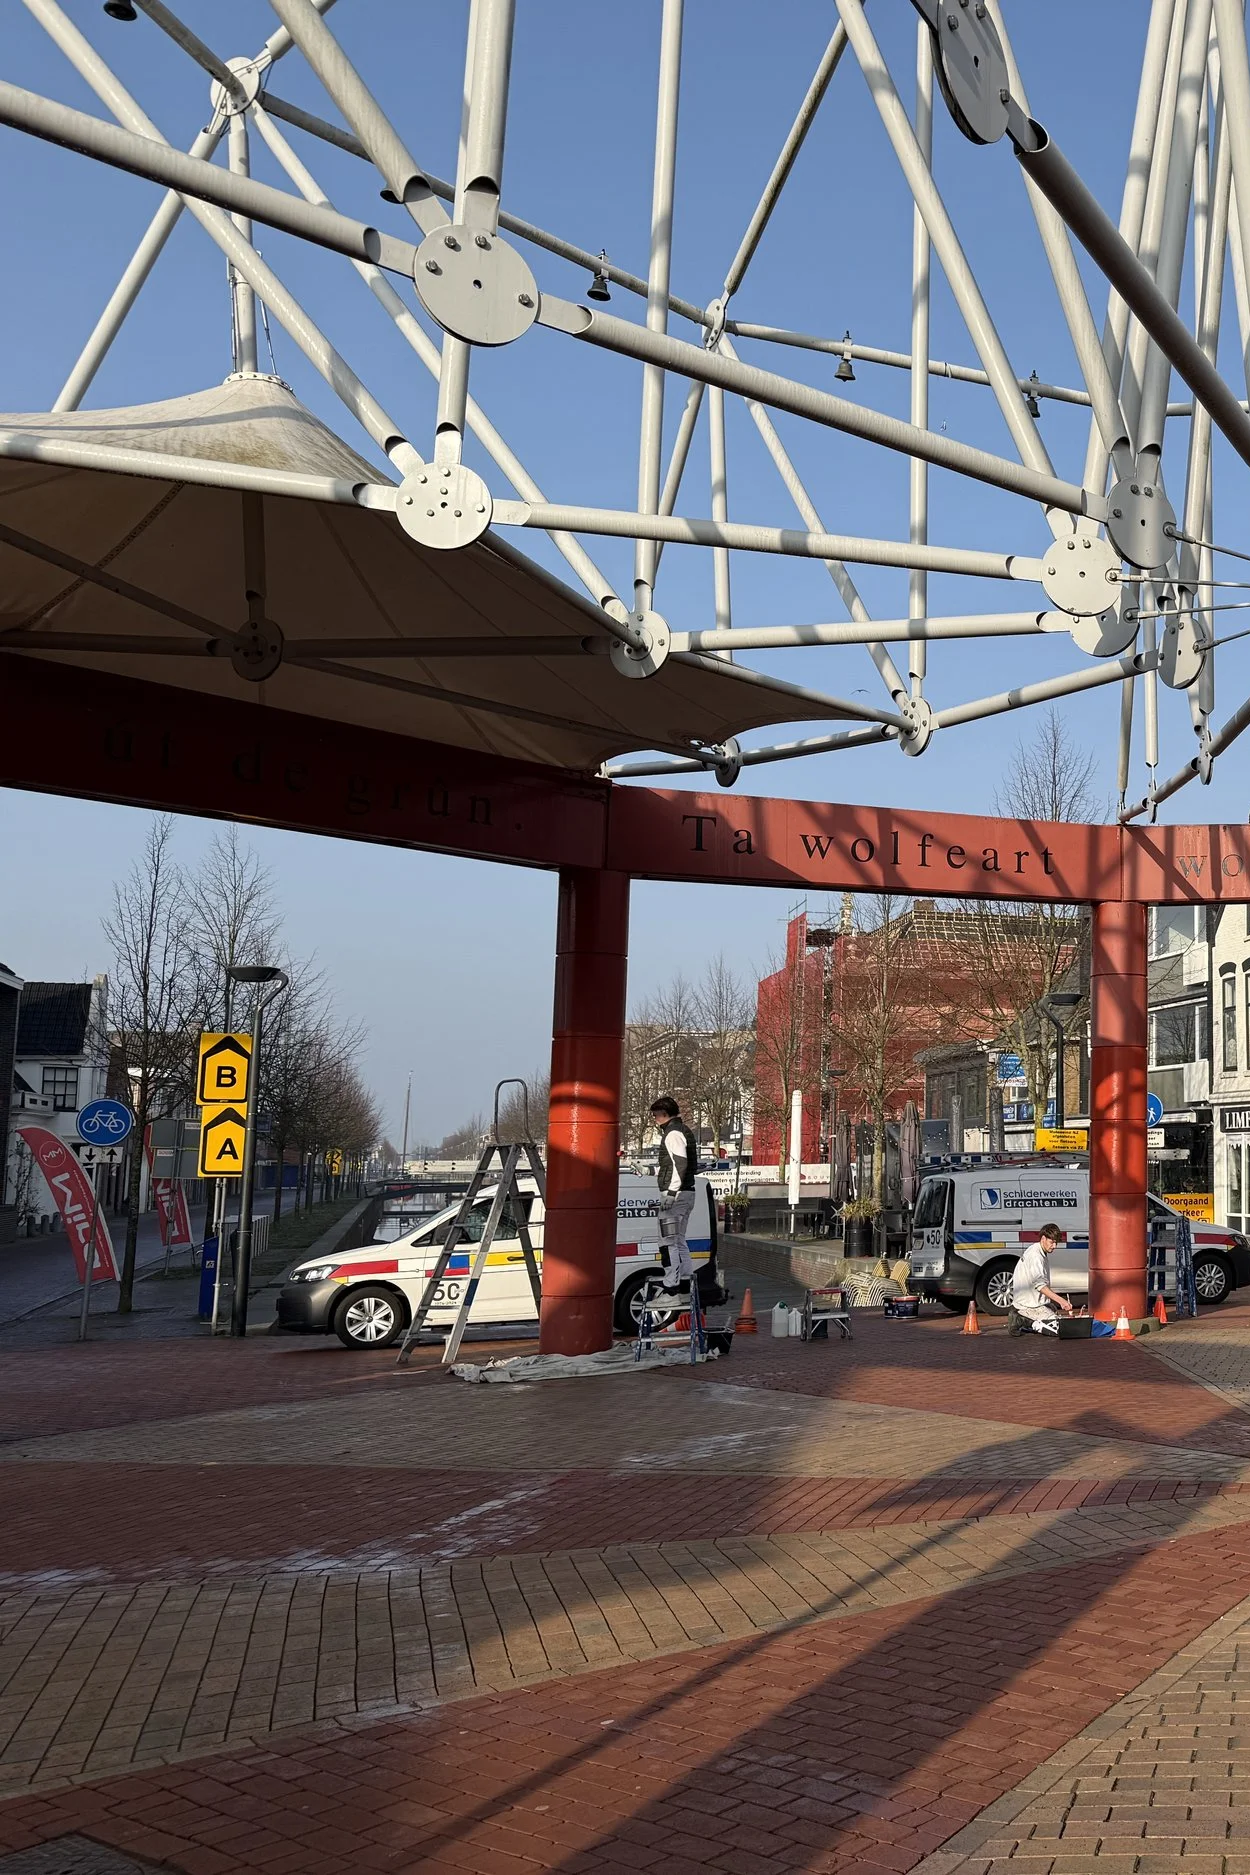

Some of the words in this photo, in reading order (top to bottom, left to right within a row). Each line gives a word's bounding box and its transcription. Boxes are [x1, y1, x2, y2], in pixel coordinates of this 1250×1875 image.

[230, 739, 311, 793] de
[681, 814, 756, 855] Ta
[799, 830, 1055, 876] wolfeart
[215, 1065, 237, 1088] B
[215, 1137, 239, 1160] A
[1003, 1190, 1077, 1198] schilderwerken
[1164, 1196, 1209, 1207] Doorgaand
[1005, 1199, 1058, 1208] drachten
[1062, 1199, 1075, 1207] bv
[1178, 1208, 1205, 1217] erkeer
